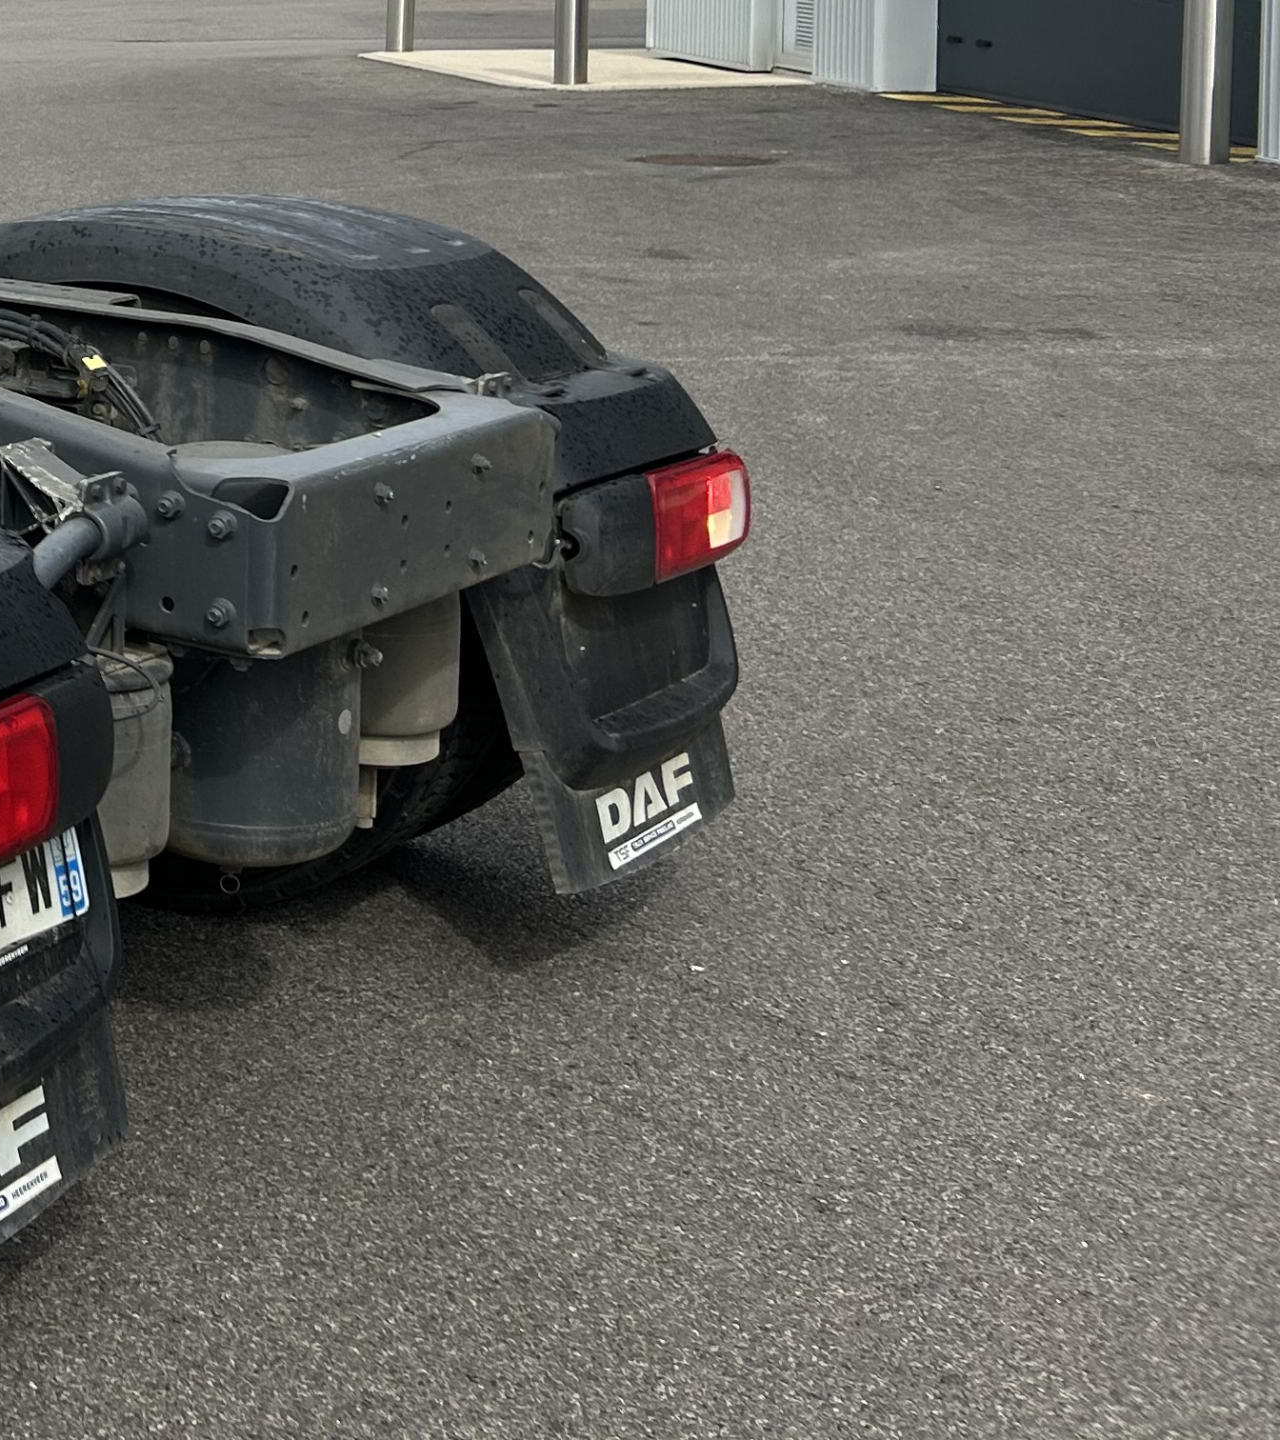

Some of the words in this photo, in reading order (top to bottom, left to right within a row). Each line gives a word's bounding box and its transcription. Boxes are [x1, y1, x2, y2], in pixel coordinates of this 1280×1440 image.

[595, 751, 694, 845] DAF
[58, 869, 83, 908] 59
[11, 1170, 49, 1201] HEERENVEEN
